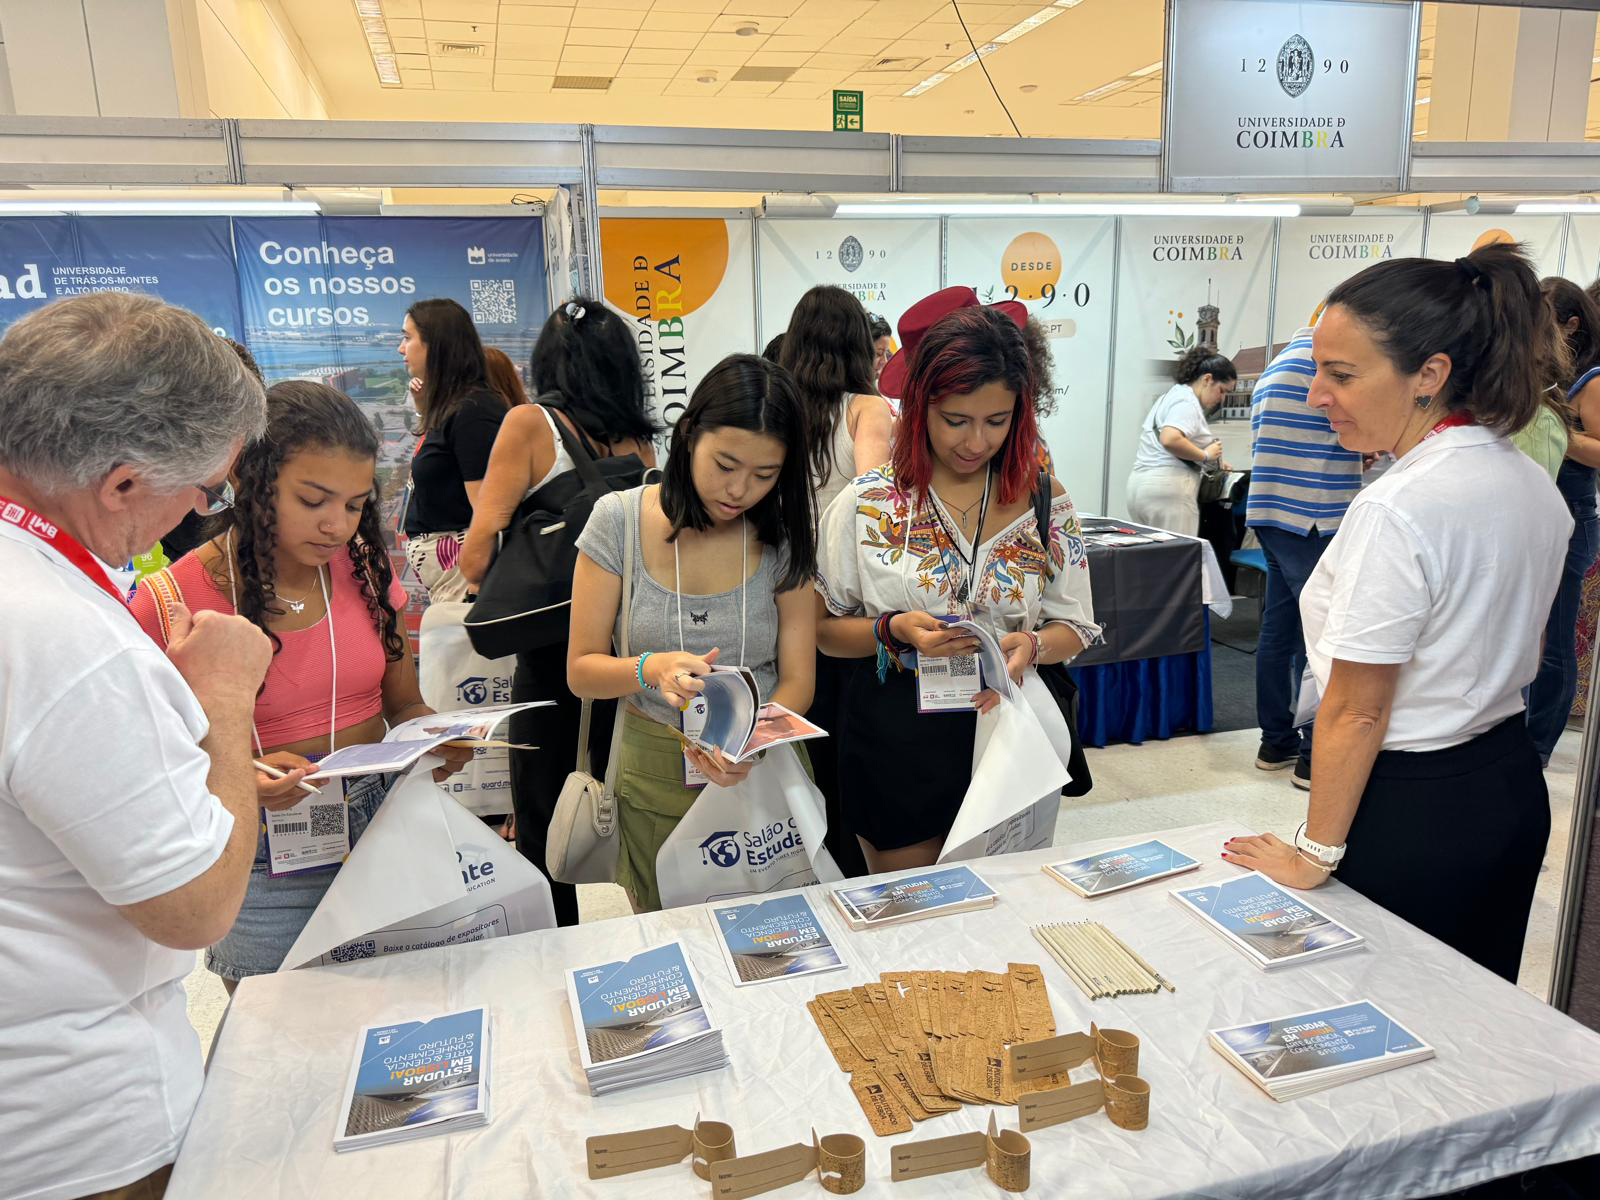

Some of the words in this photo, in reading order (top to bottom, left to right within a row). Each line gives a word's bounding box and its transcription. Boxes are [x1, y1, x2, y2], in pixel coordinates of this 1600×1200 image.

[1238, 117, 1333, 128] UNIVERSIDADE
[1236, 130, 1345, 149] COIMBRA
[1153, 234, 1234, 245] UNIVERSIDADE
[1310, 233, 1386, 244] UNIVERSIDADE
[259, 240, 395, 271] Conheça
[1152, 246, 1243, 262] COIMBRA
[1309, 244, 1393, 260] COIMBRA
[52, 266, 126, 275] UNIVERSIDADE
[1011, 262, 1052, 272] DESDE
[54, 277, 68, 285] DE
[70, 275, 160, 285] TRÁS-OS-MONTES
[264, 276, 300, 296] os
[309, 276, 416, 295] nossos
[64, 286, 90, 295] ALTO
[268, 306, 370, 326] cursos
[28, 514, 58, 539] BMI
[743, 822, 784, 848] Salão
[746, 831, 804, 866] Estuda
[466, 878, 496, 892] UCATION
[383, 944, 404, 953] Baixe
[412, 940, 445, 951] catálogo
[458, 918, 500, 940] expositores
[798, 926, 818, 936] EM
[766, 932, 821, 948] ESTUDAR
[629, 968, 671, 986] FUTURO
[658, 977, 685, 990] ARTE
[600, 971, 684, 1000] CONHECIMENTO
[666, 984, 689, 998] EM
[627, 990, 691, 1017] ESTUDAR
[1282, 1020, 1328, 1035] ESTUDAR
[418, 1035, 464, 1050] FUTURO
[1281, 1034, 1300, 1043] EM
[383, 1040, 474, 1064] CONHECIMENTO
[444, 1048, 474, 1060] ARTE
[450, 1055, 473, 1068] EM
[402, 1063, 472, 1086] ESTUDAR
